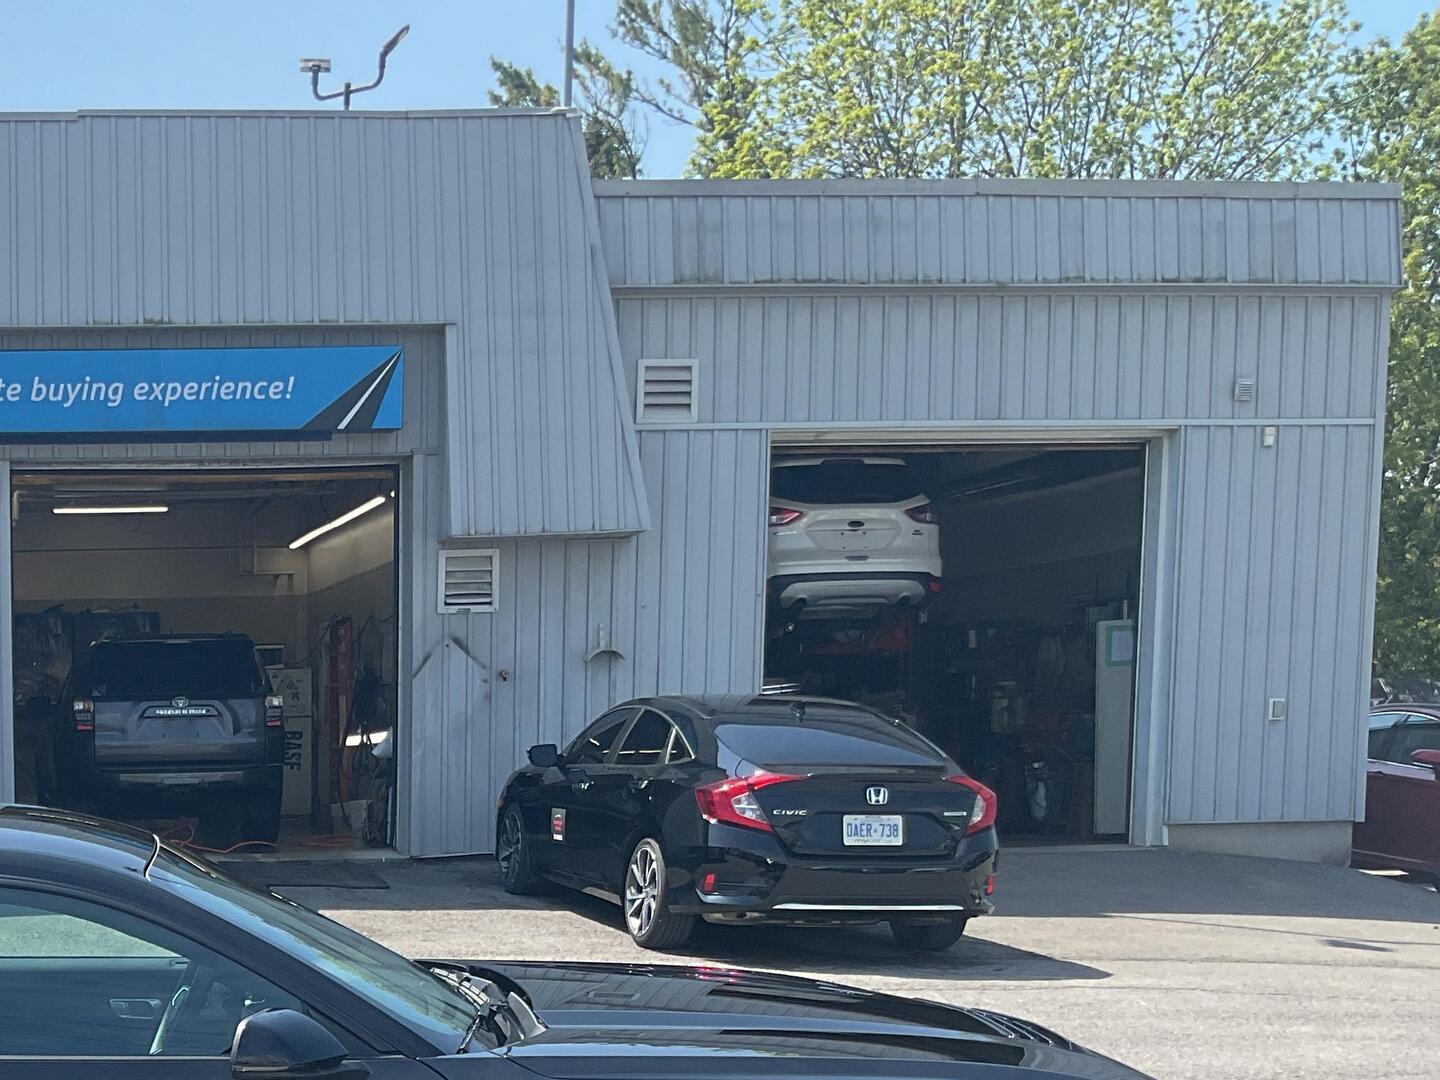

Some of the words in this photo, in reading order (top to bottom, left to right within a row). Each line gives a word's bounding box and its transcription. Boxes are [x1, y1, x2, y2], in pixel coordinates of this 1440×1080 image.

[31, 376, 124, 407] buying
[133, 375, 296, 406] experience!
[846, 823, 873, 838] DAER
[879, 823, 900, 839] 738
